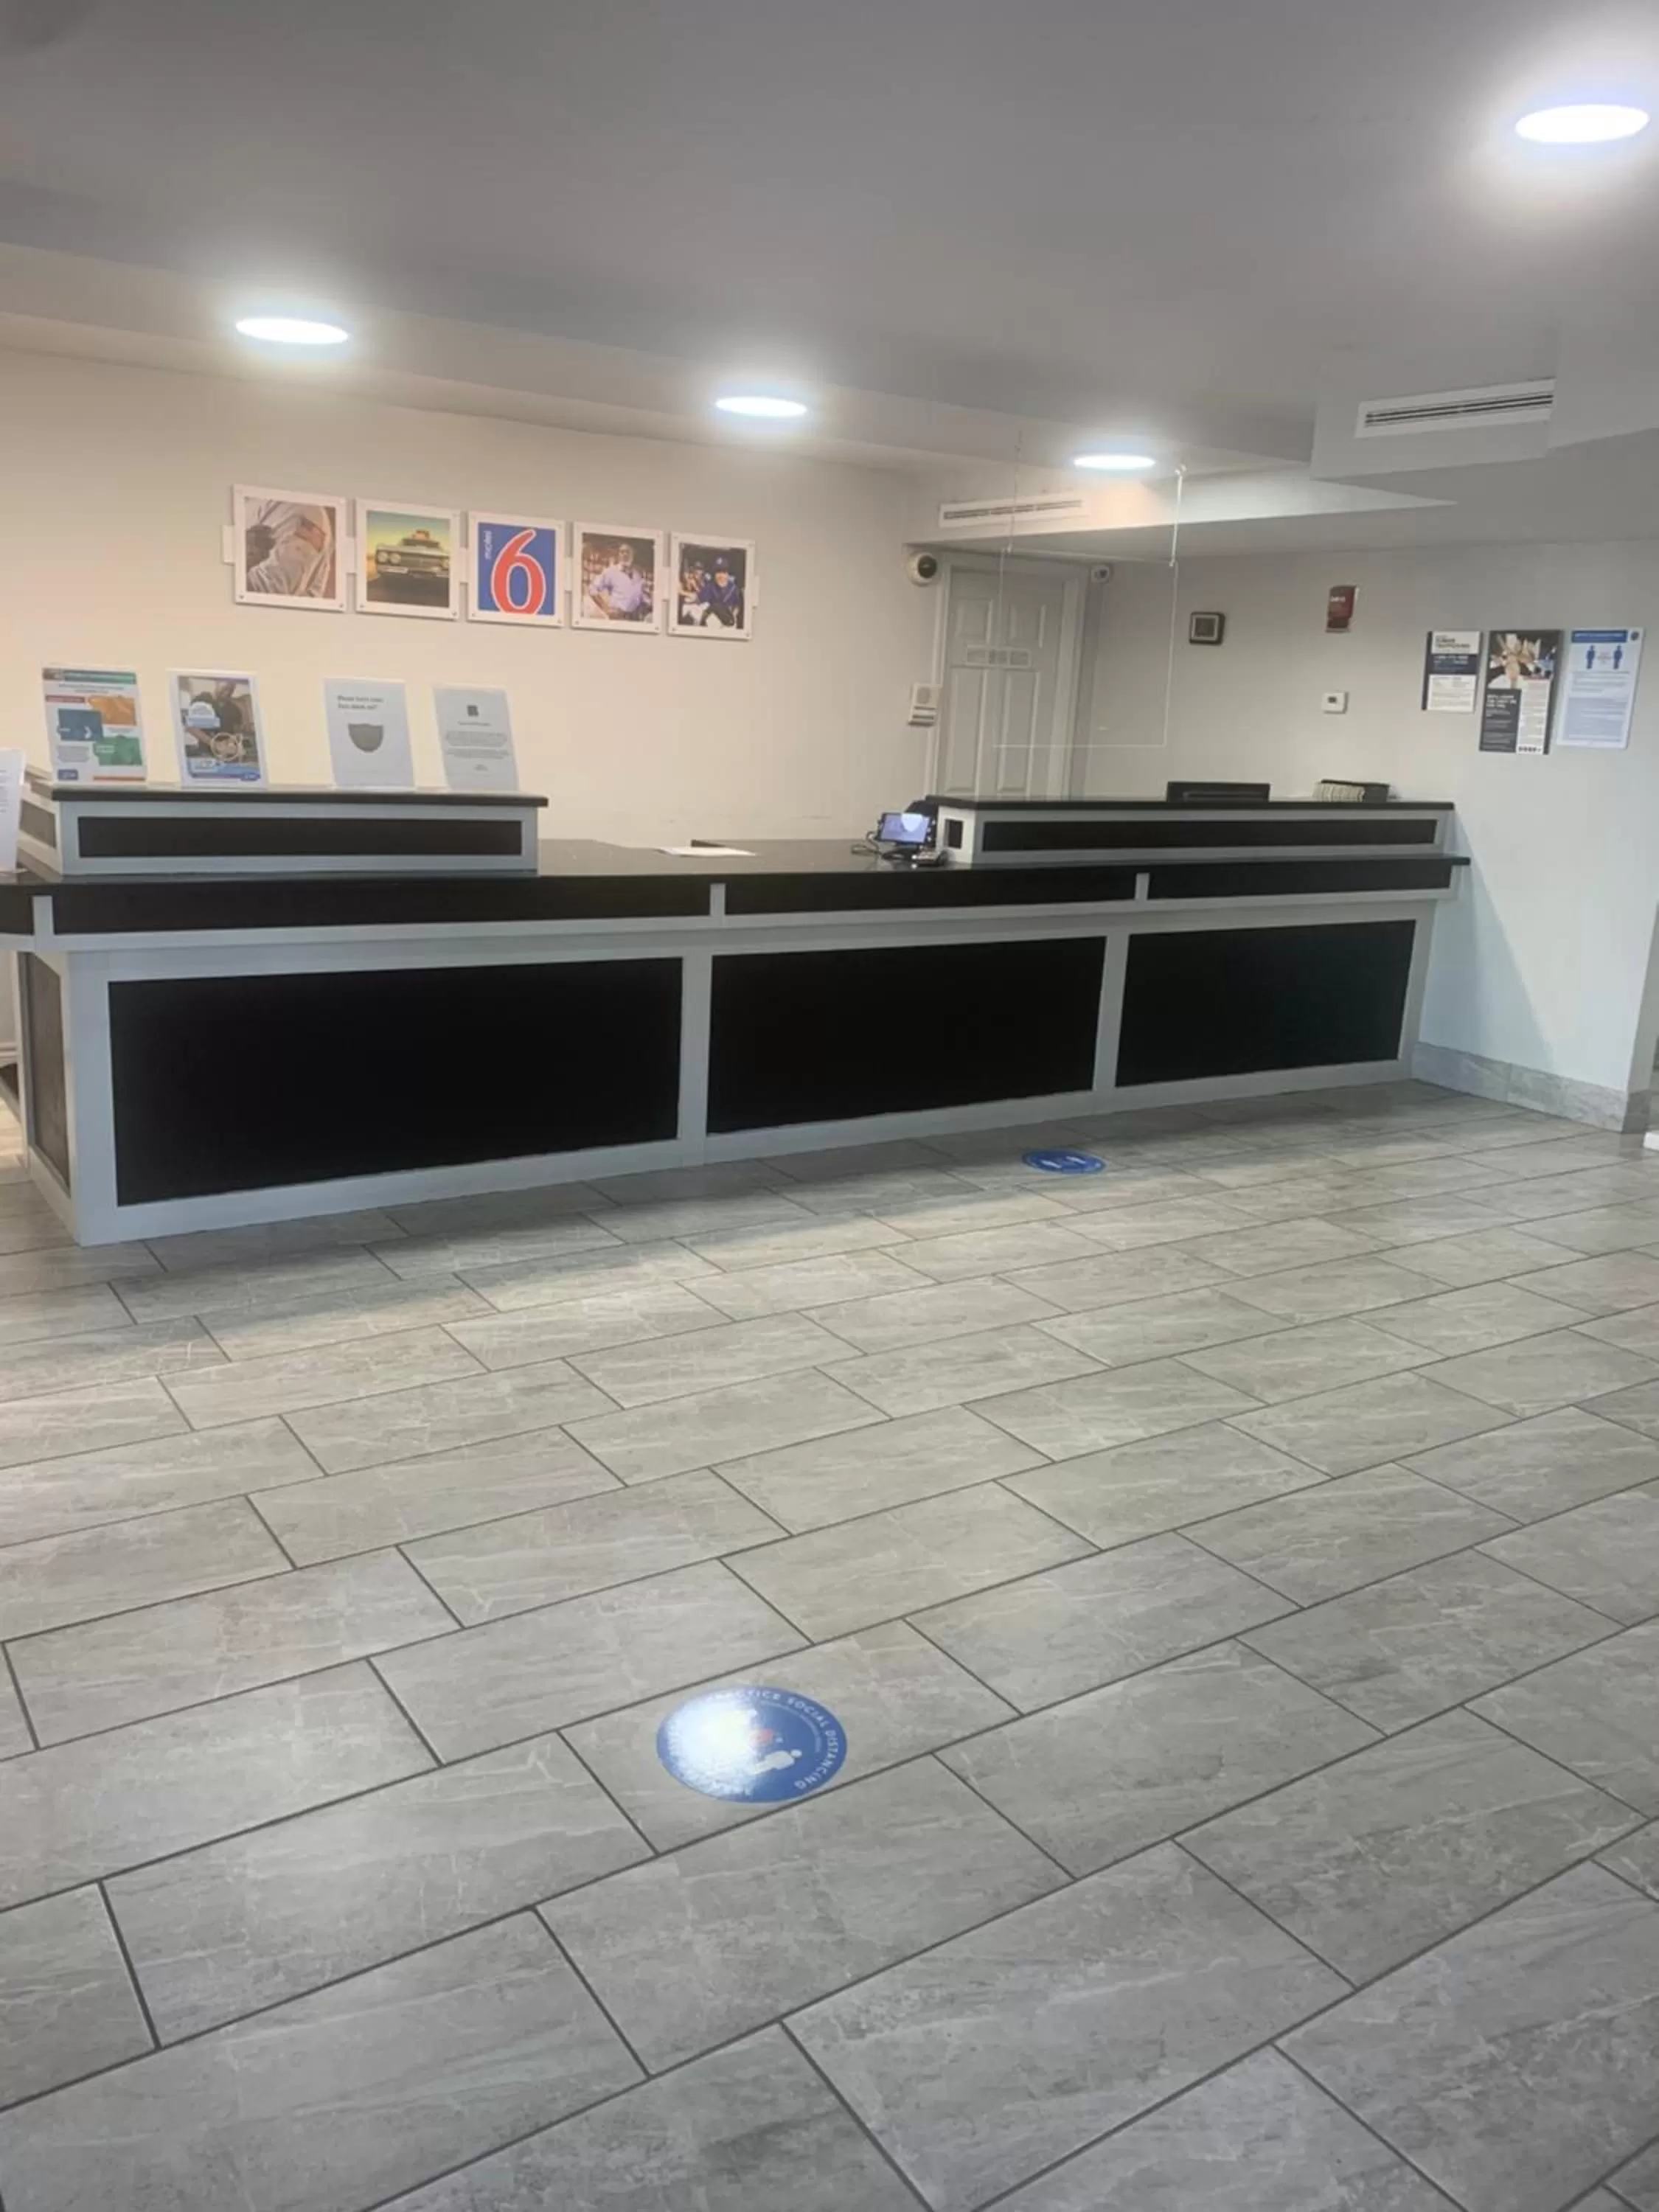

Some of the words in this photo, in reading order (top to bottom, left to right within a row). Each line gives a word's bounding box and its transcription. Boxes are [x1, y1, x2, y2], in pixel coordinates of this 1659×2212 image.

[490, 529, 546, 614] 6
[787, 1697, 830, 1727] SOCIAL
[794, 1730, 838, 1790] DISTANCING
